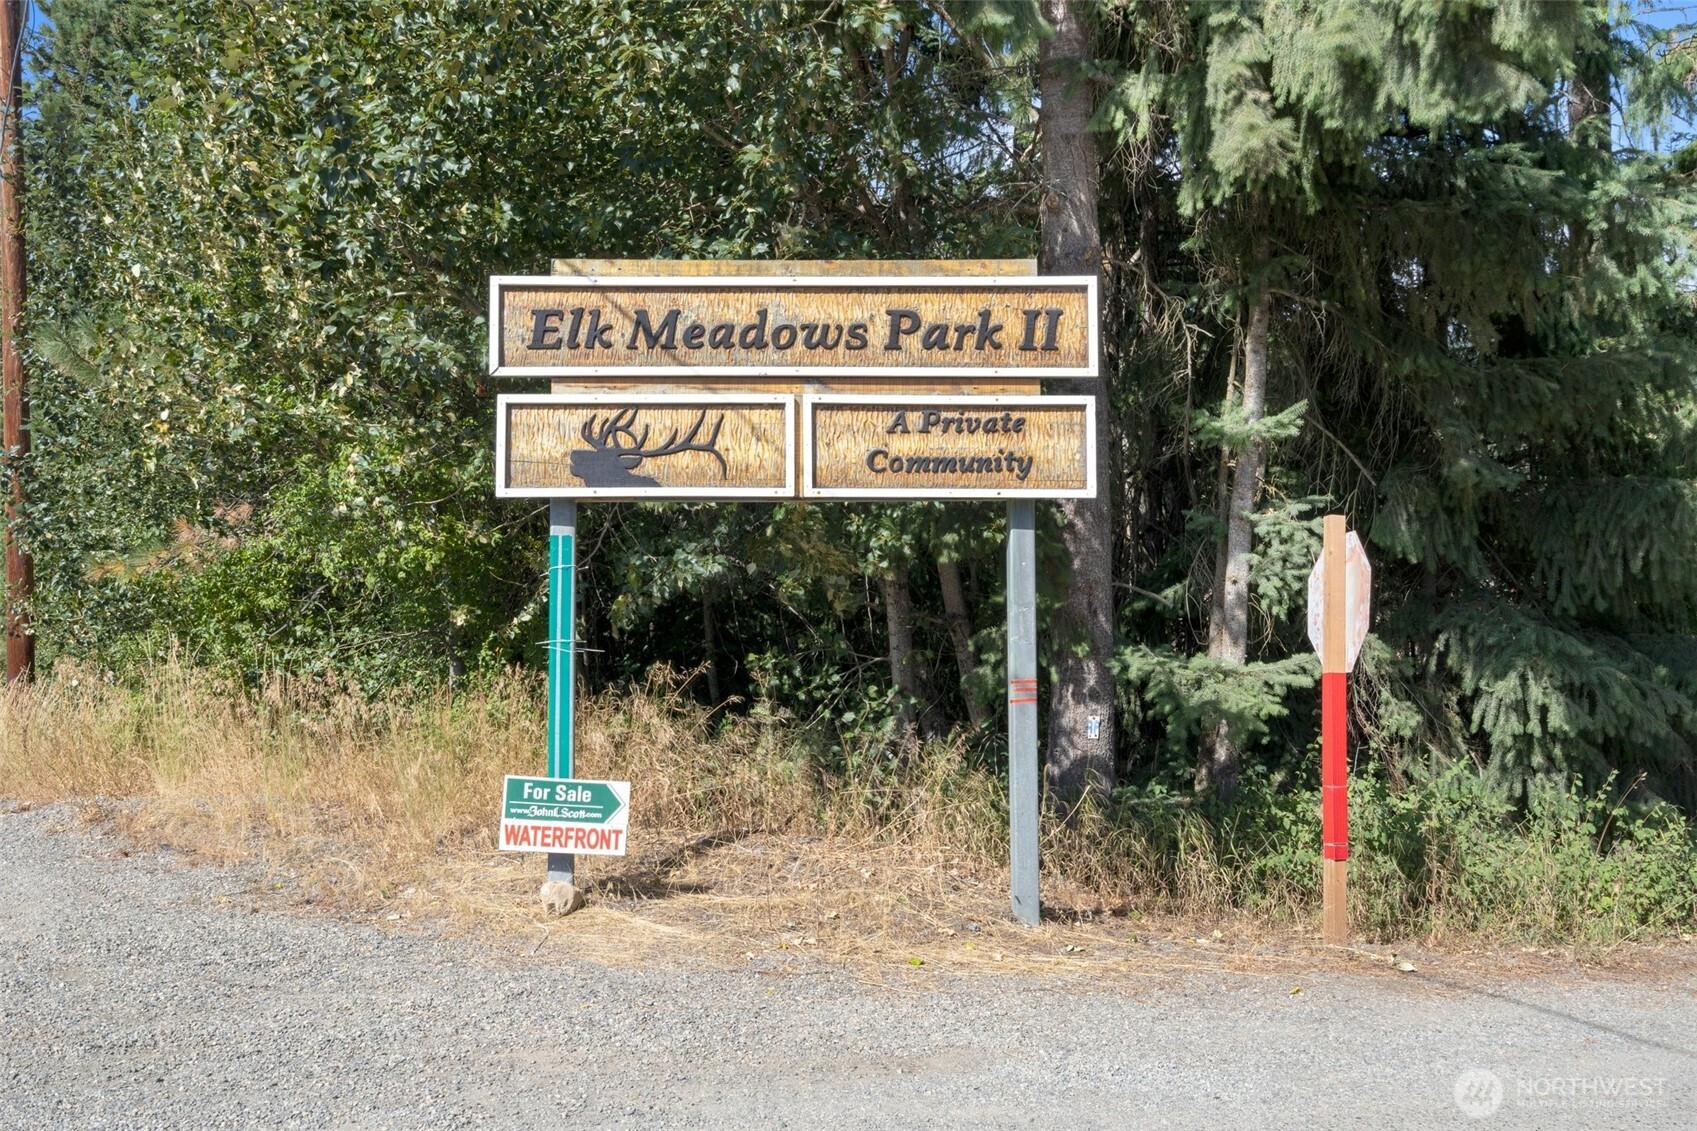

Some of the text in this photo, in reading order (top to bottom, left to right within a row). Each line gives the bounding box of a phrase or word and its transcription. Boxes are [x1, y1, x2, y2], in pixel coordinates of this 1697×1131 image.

[526, 306, 1064, 352] Elk Meadows Park II
[886, 410, 1026, 435] A Private
[866, 448, 1034, 481] Community
[523, 782, 592, 802] For Sale
[504, 824, 623, 850] WATERFRONT
